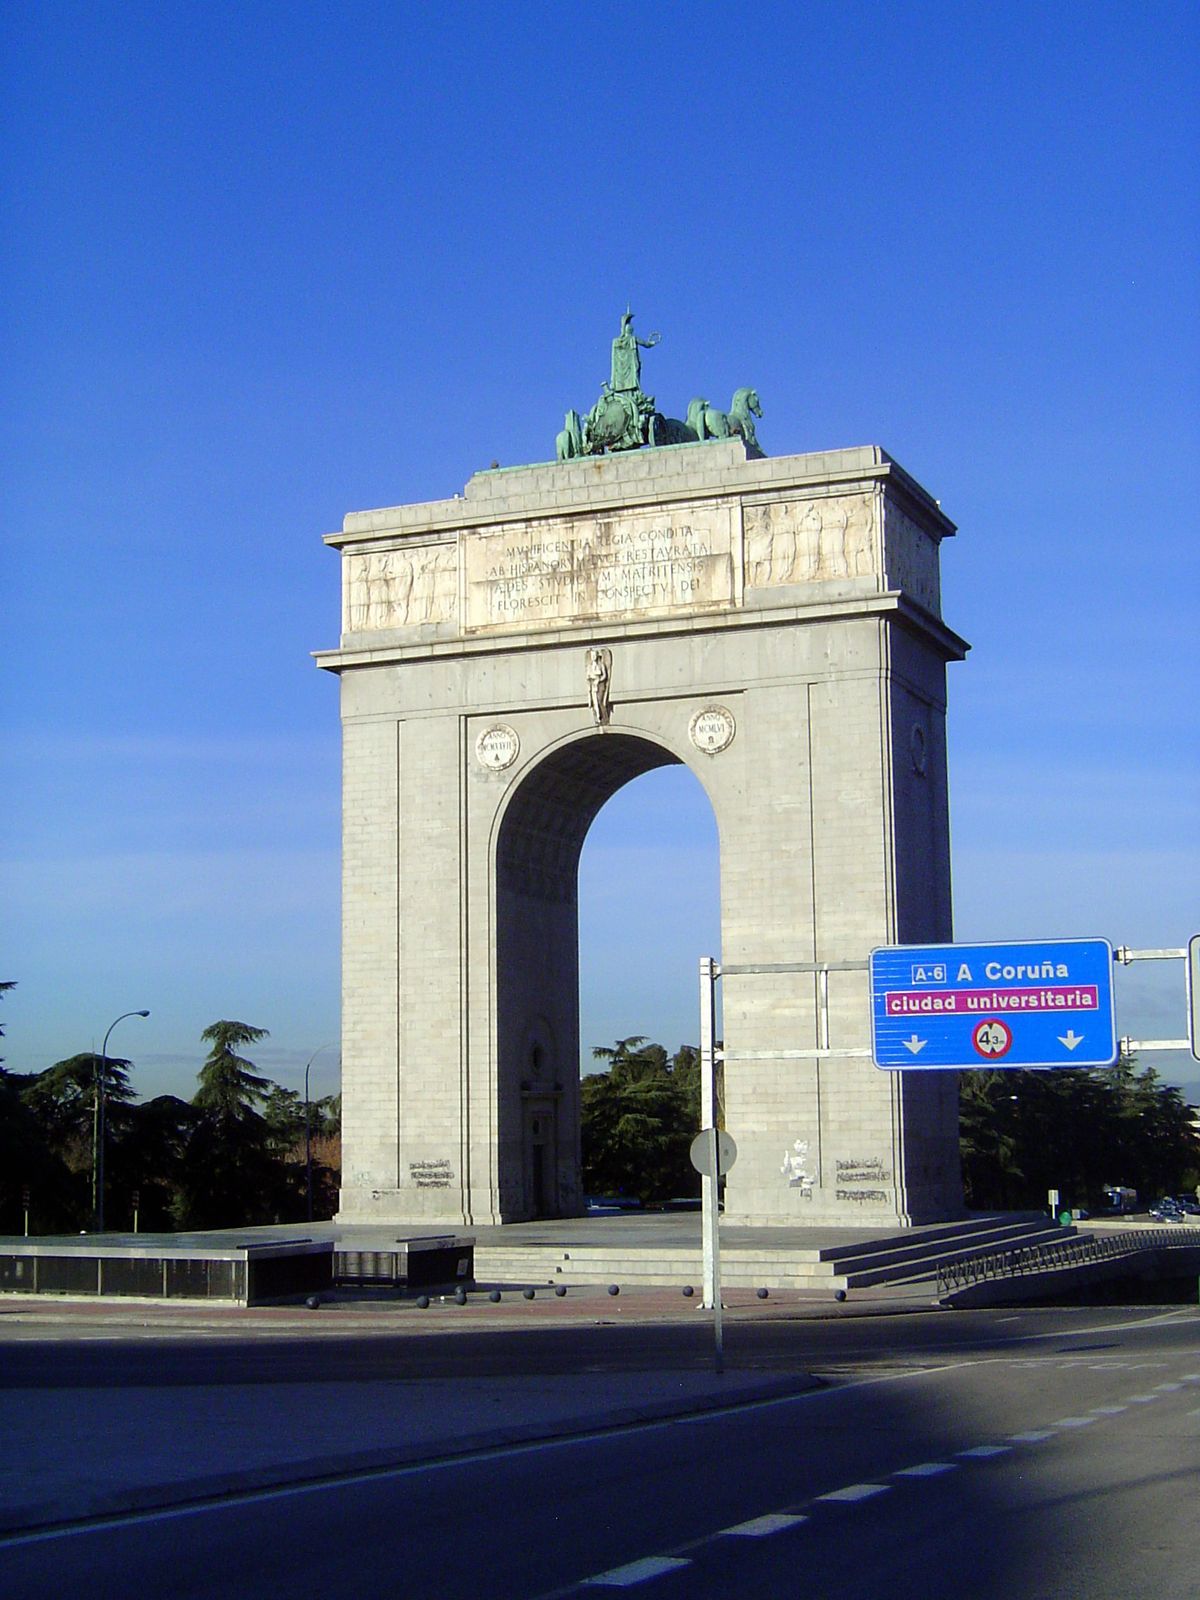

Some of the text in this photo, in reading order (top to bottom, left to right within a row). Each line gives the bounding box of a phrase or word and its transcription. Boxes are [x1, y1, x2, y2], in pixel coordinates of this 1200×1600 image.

[638, 525, 694, 541] CONDITA
[489, 565, 505, 578] AB
[626, 543, 708, 562] RESTAVRATA
[621, 559, 704, 582] MATRITENSIS
[497, 594, 561, 611] FLORESCIT
[574, 591, 586, 603] IN
[680, 578, 701, 592] DEI
[914, 961, 1069, 982] A-6 A Coruña
[890, 990, 1093, 1012] ciudad universitaria
